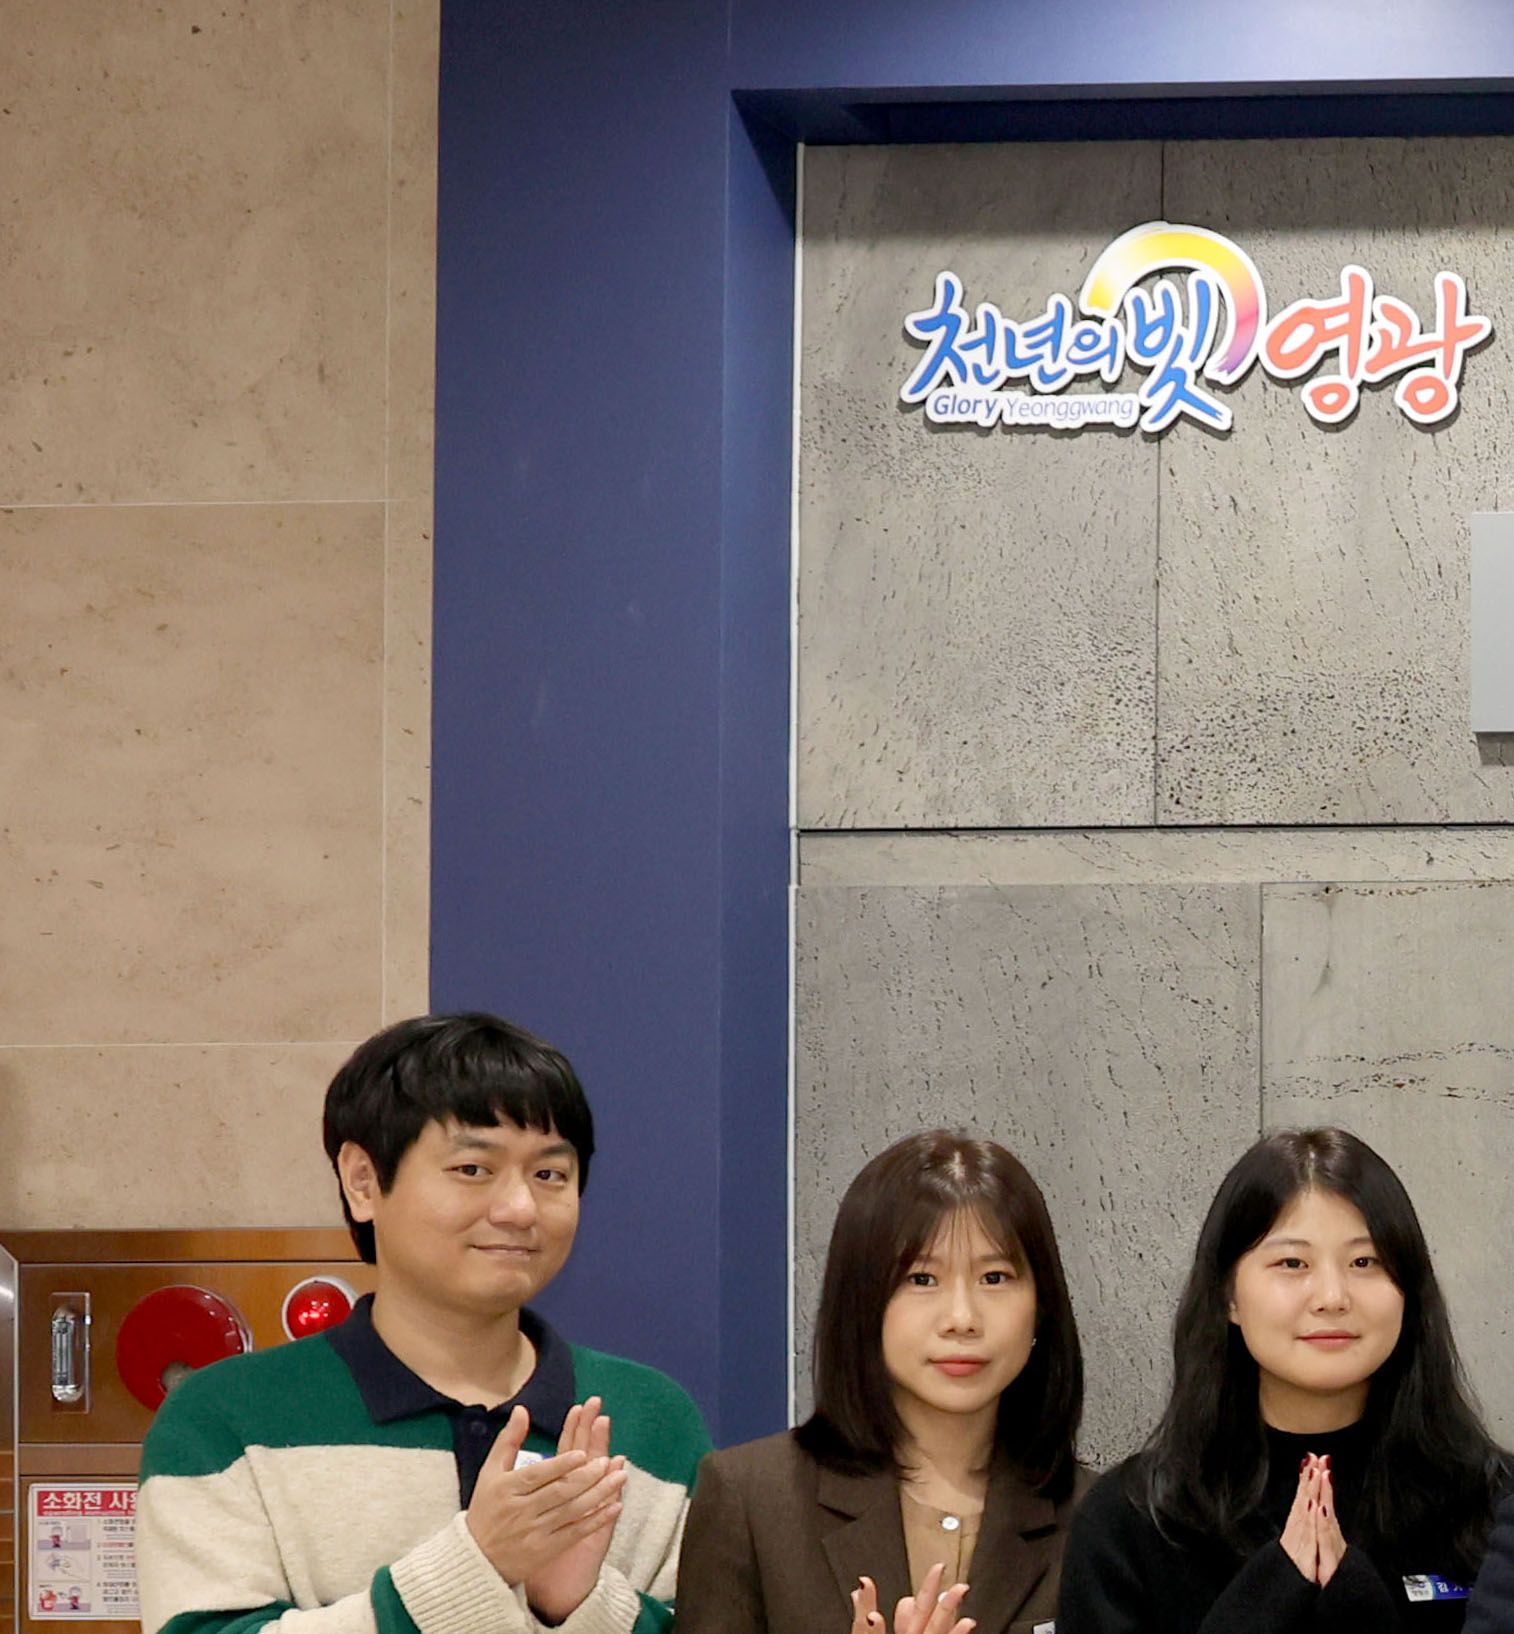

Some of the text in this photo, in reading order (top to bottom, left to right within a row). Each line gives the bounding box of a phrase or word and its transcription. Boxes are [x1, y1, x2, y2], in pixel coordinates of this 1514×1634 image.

[1265, 271, 1483, 414] 영광
[933, 394, 1134, 422] Glory Yeonggwang
[43, 1492, 102, 1510] 소화전
